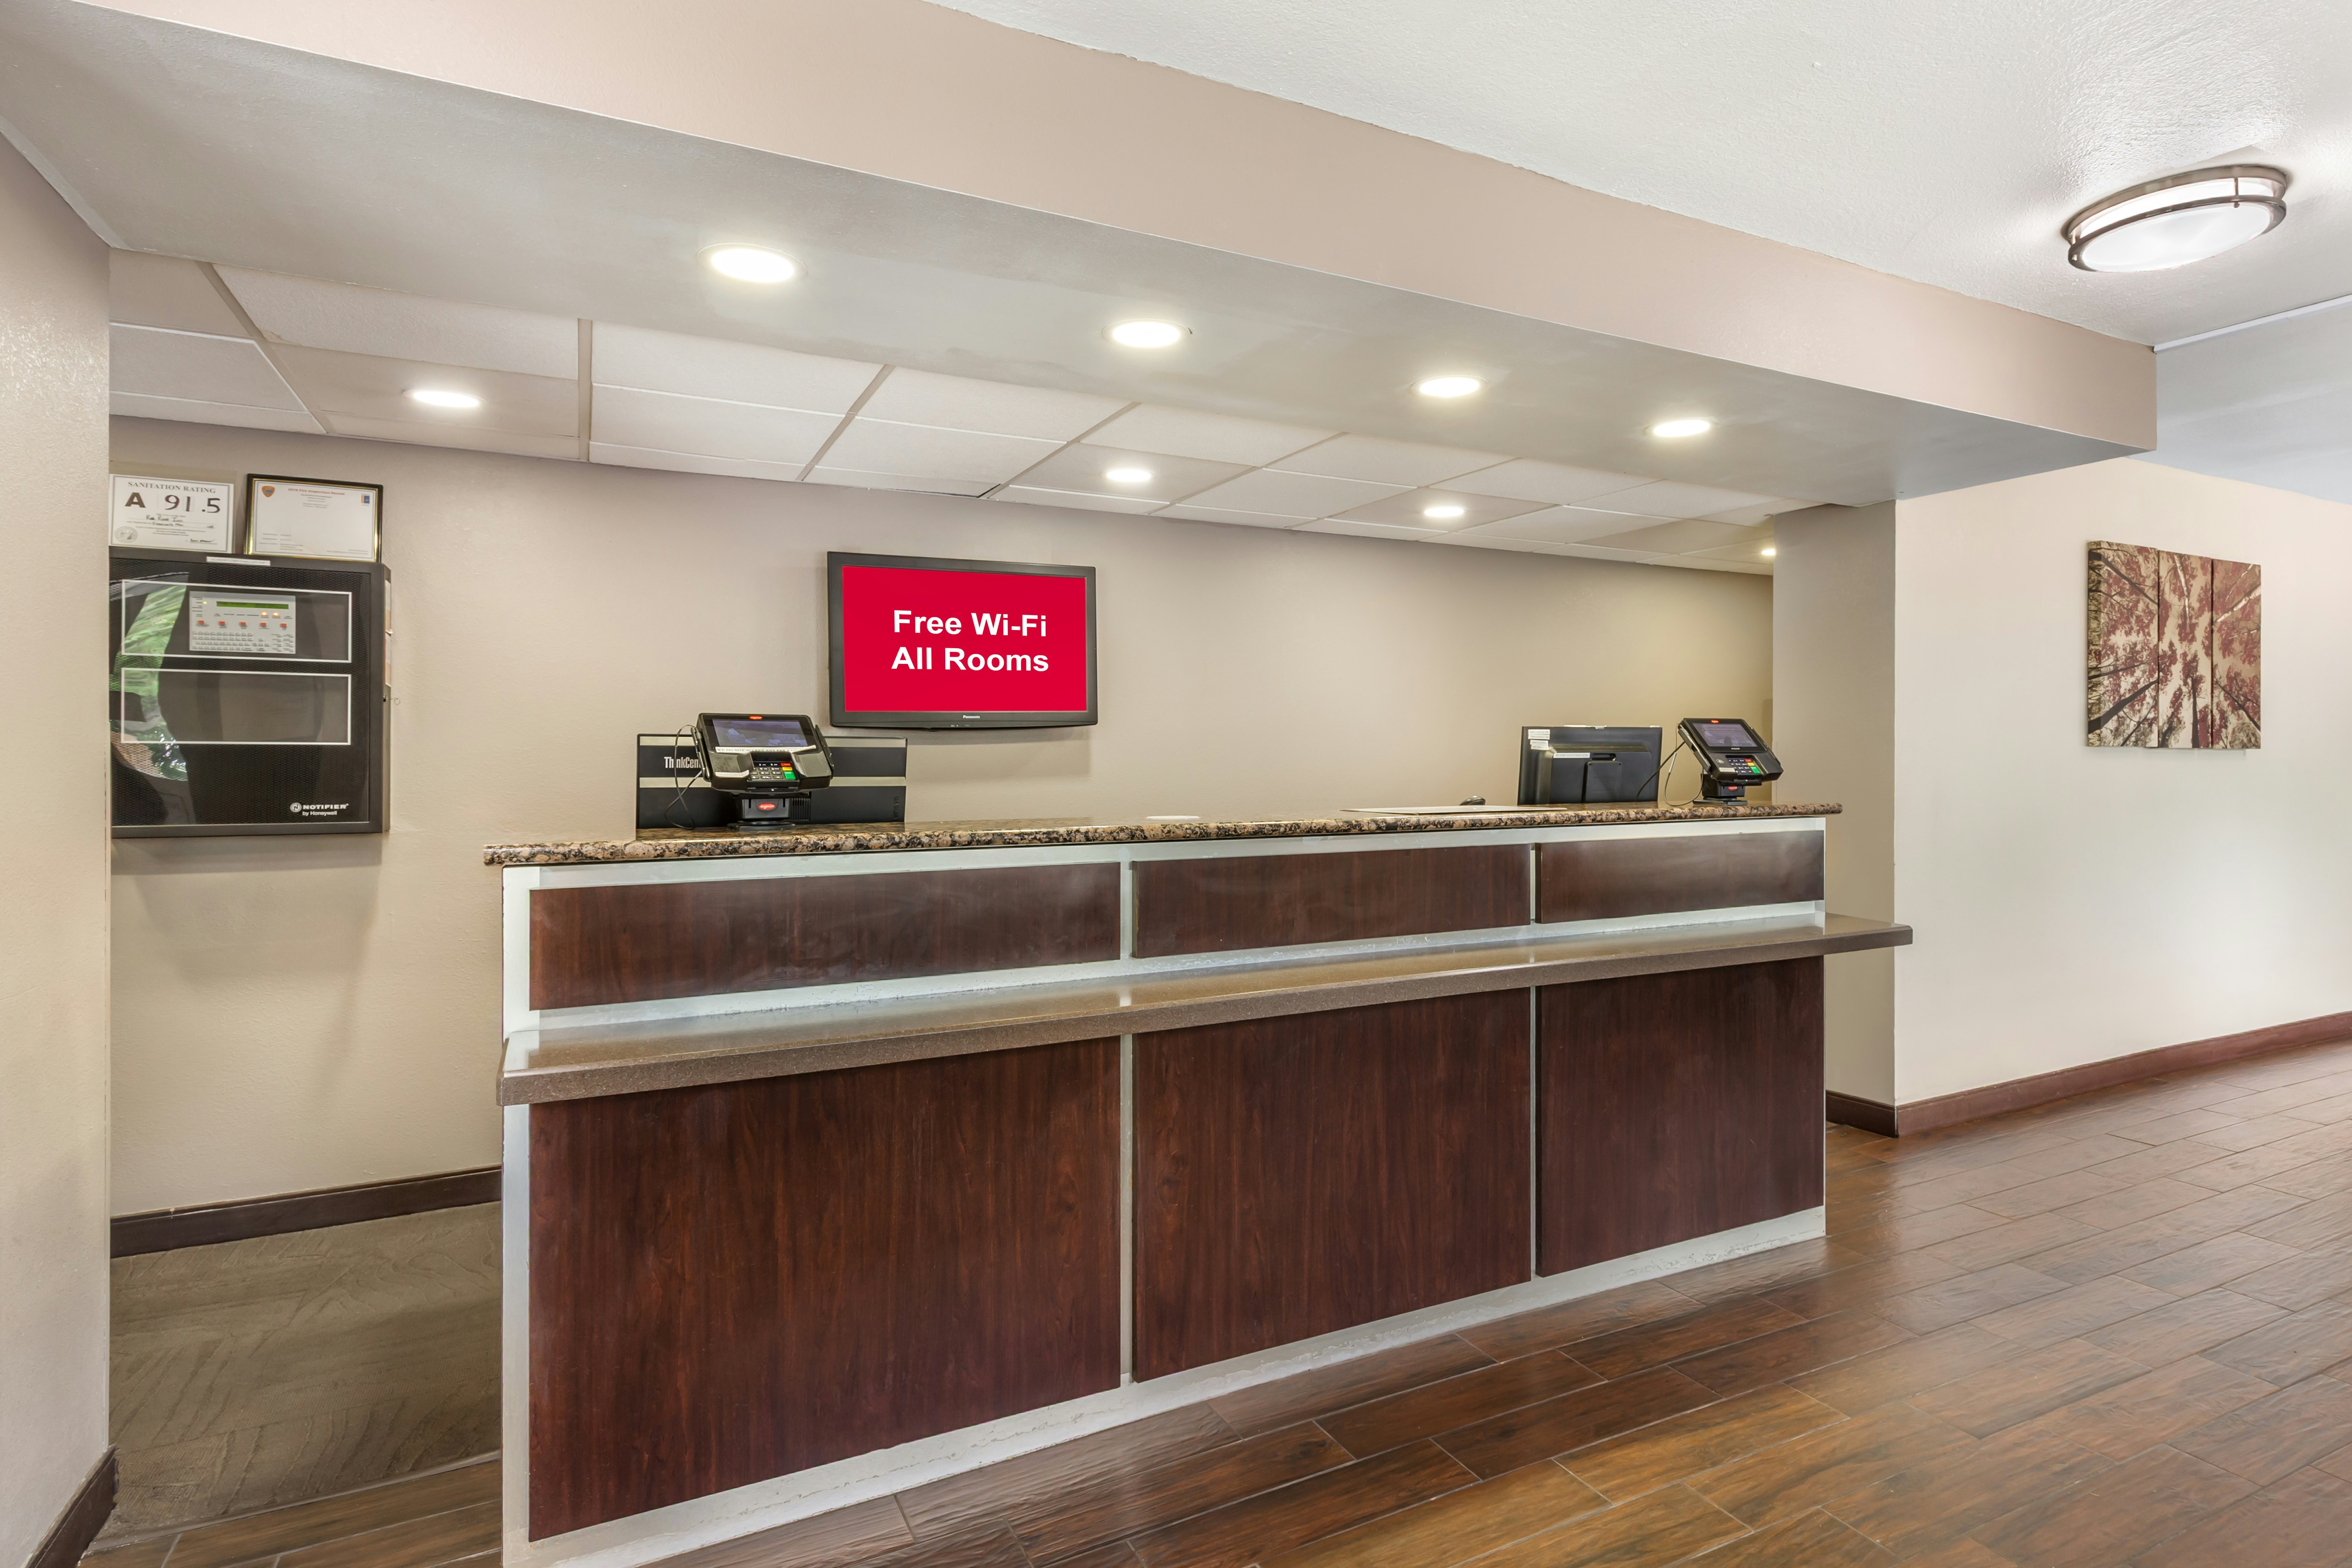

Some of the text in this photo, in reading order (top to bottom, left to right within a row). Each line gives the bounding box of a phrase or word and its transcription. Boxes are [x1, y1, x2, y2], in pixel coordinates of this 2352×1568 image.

[128, 481, 181, 490] SANITATION
[125, 492, 146, 508] A
[894, 609, 1047, 637] Free Wi-Fi
[891, 646, 1049, 672] All Rooms
[664, 756, 701, 768] ThnkCen
